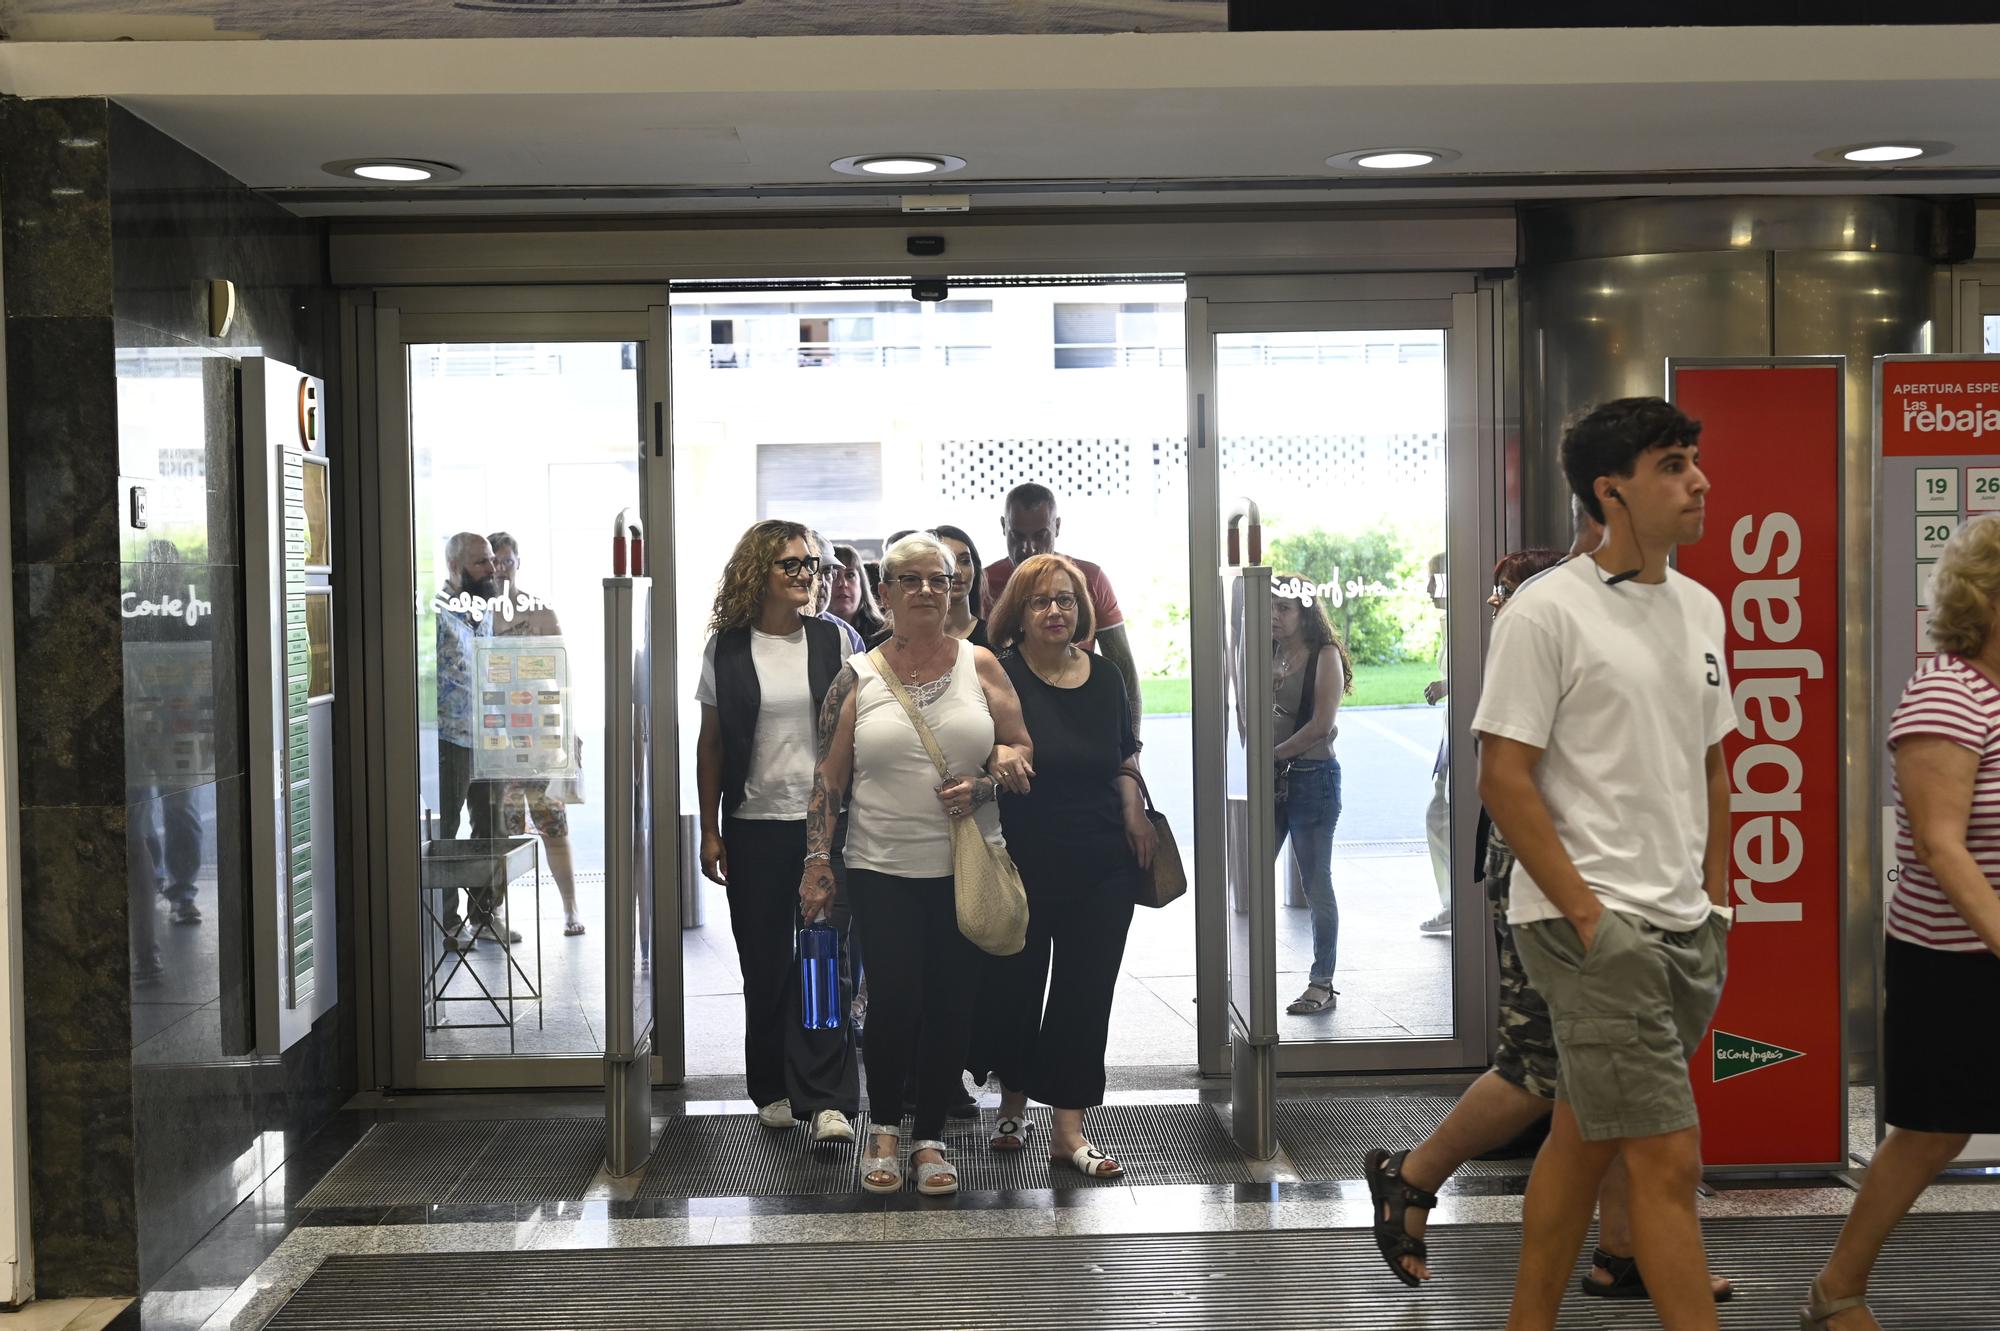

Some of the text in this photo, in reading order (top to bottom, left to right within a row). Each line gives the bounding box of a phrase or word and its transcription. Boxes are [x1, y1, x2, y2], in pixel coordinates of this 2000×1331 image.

[1893, 382, 2000, 395] APERTURA ESPE
[1903, 398, 1928, 411] Las
[1925, 478, 1948, 494] 19
[1975, 477, 2000, 493] 26
[1924, 525, 1950, 541] 20
[121, 591, 184, 618] Corte
[1729, 511, 1824, 923] rebajas
[1716, 1048, 1727, 1060] El
[1727, 1048, 1750, 1060] Corte
